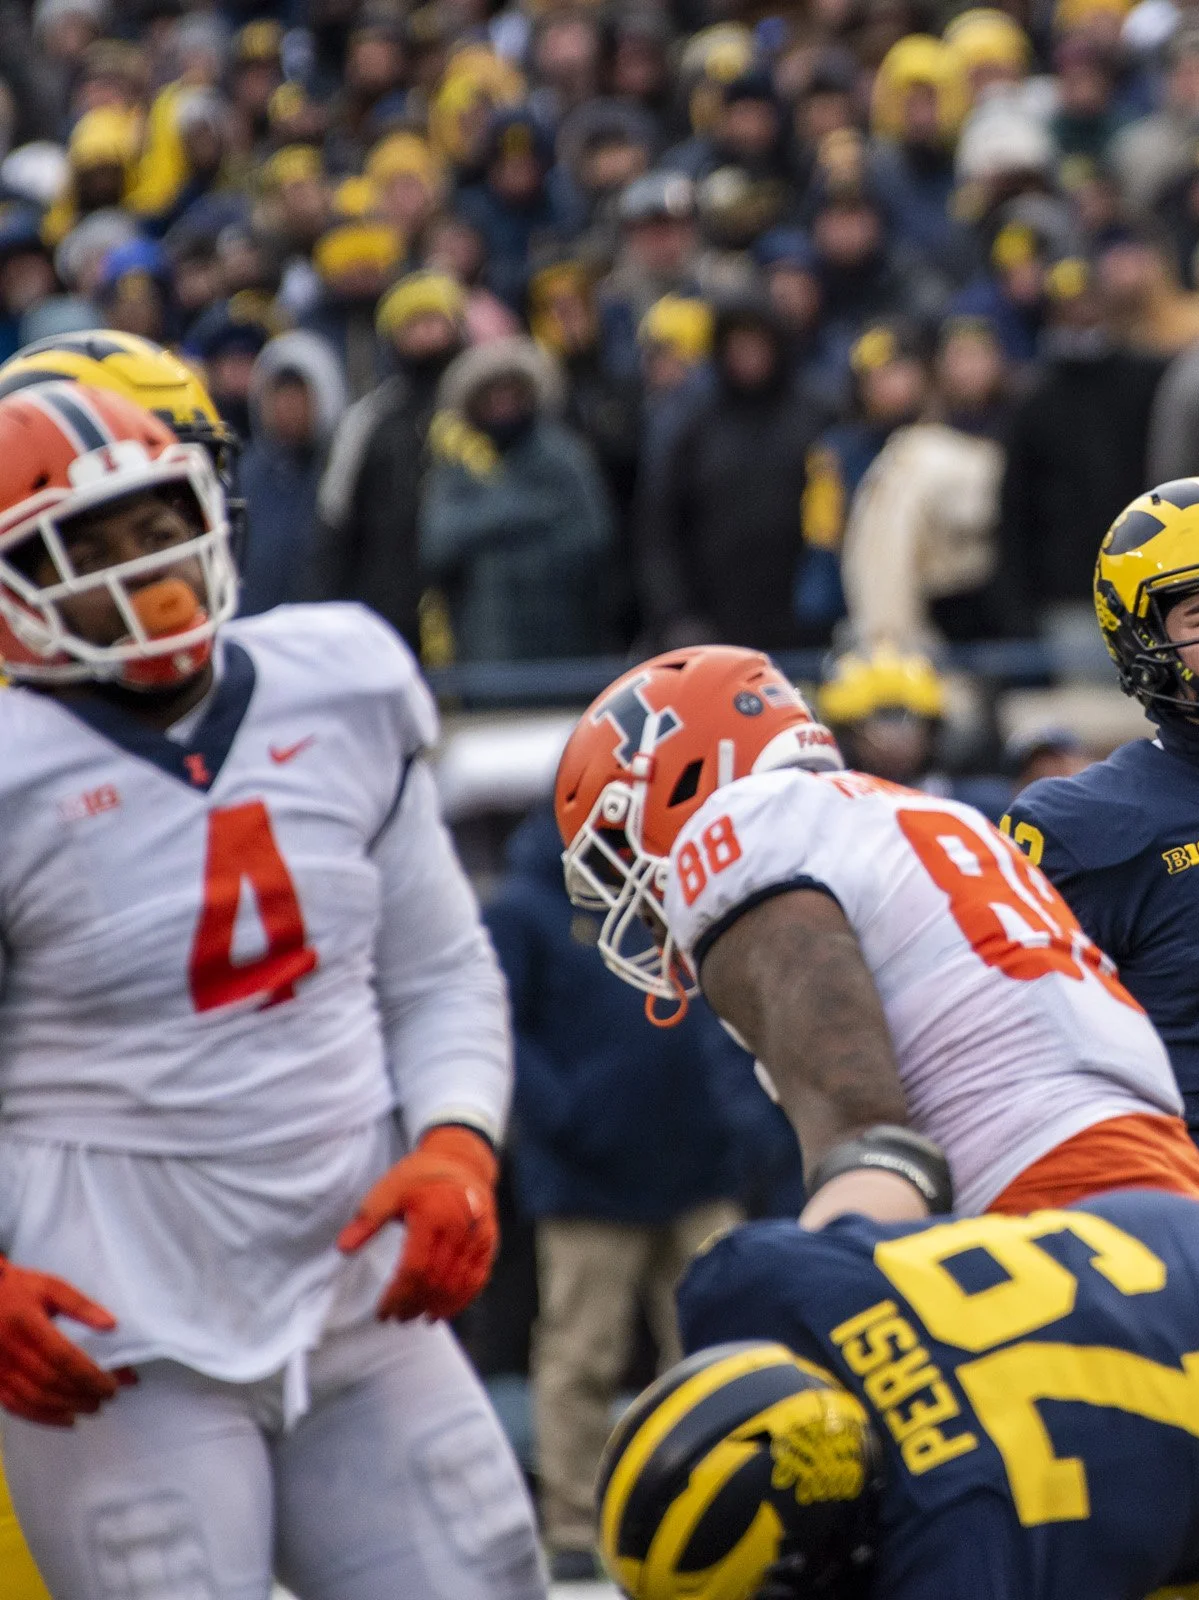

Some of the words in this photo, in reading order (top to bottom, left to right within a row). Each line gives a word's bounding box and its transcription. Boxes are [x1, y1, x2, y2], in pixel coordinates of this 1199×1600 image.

[188, 799, 319, 1012] 4
[677, 814, 743, 908] 88
[830, 1299, 979, 1477] PERSI
